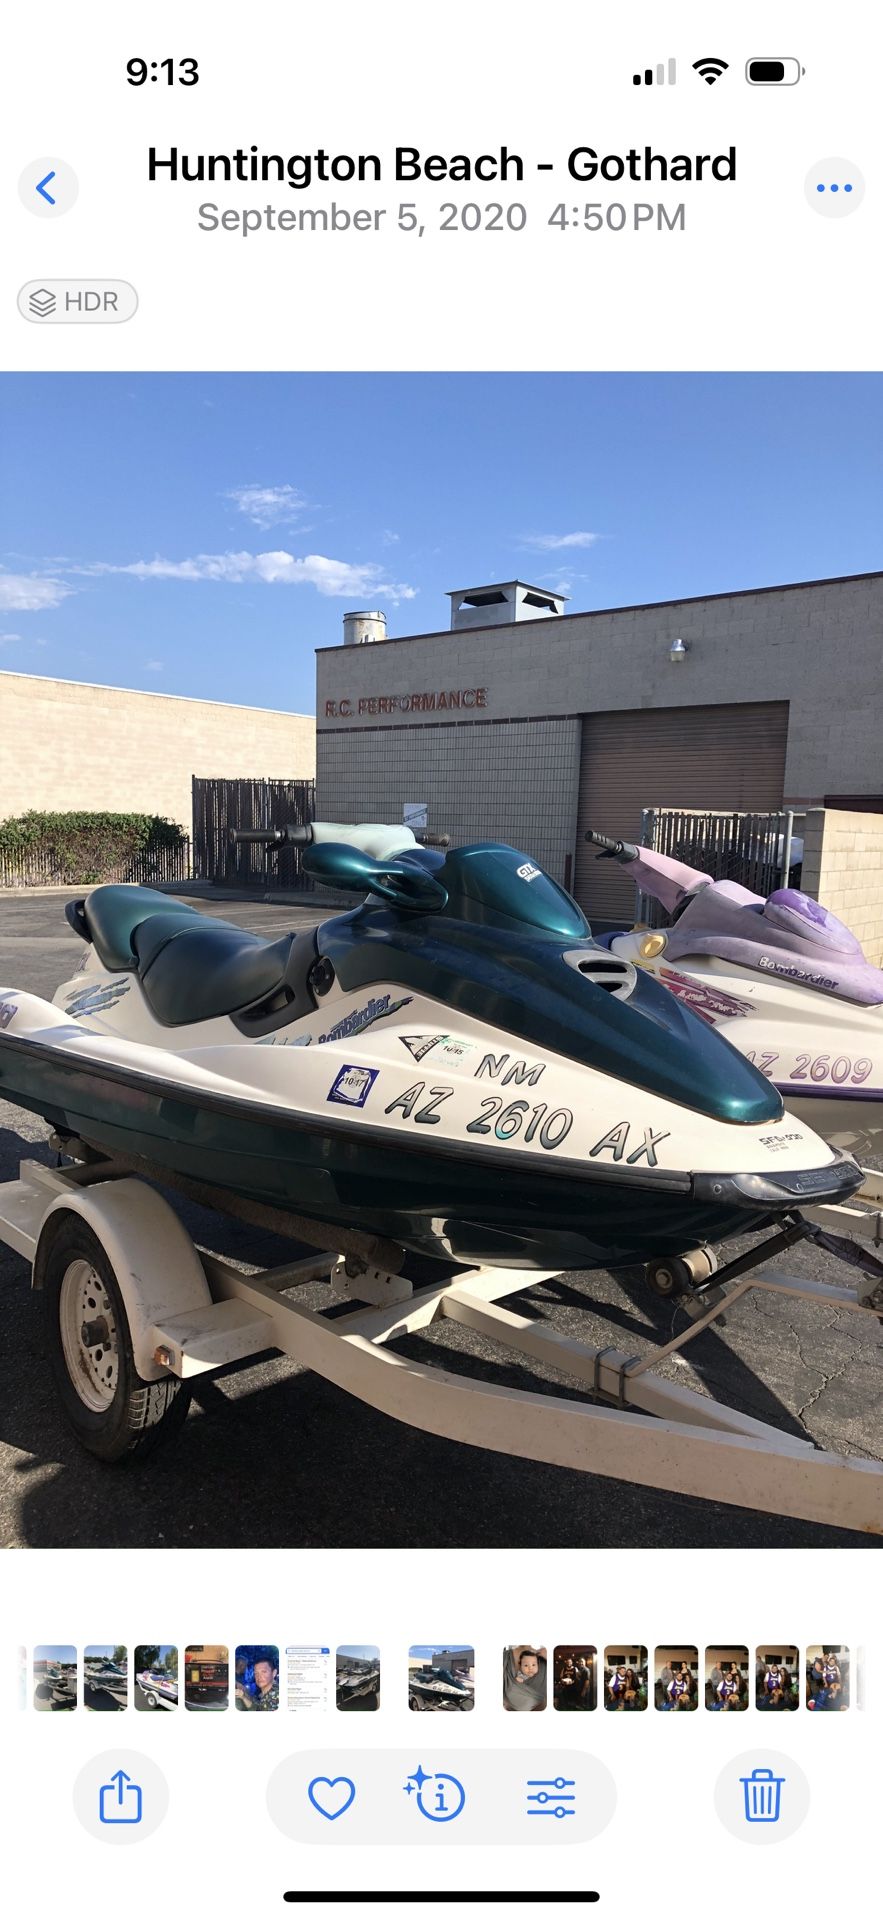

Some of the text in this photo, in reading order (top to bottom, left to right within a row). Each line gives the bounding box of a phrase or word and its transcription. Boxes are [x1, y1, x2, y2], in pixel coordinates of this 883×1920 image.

[358, 687, 489, 715] PERFORMANCE
[758, 956, 840, 990] Bombardier
[318, 994, 391, 1045] Bombardier
[473, 1053, 547, 1087] NM
[789, 1054, 873, 1084] 2609
[384, 1081, 672, 1168] AZ 2610 AX
